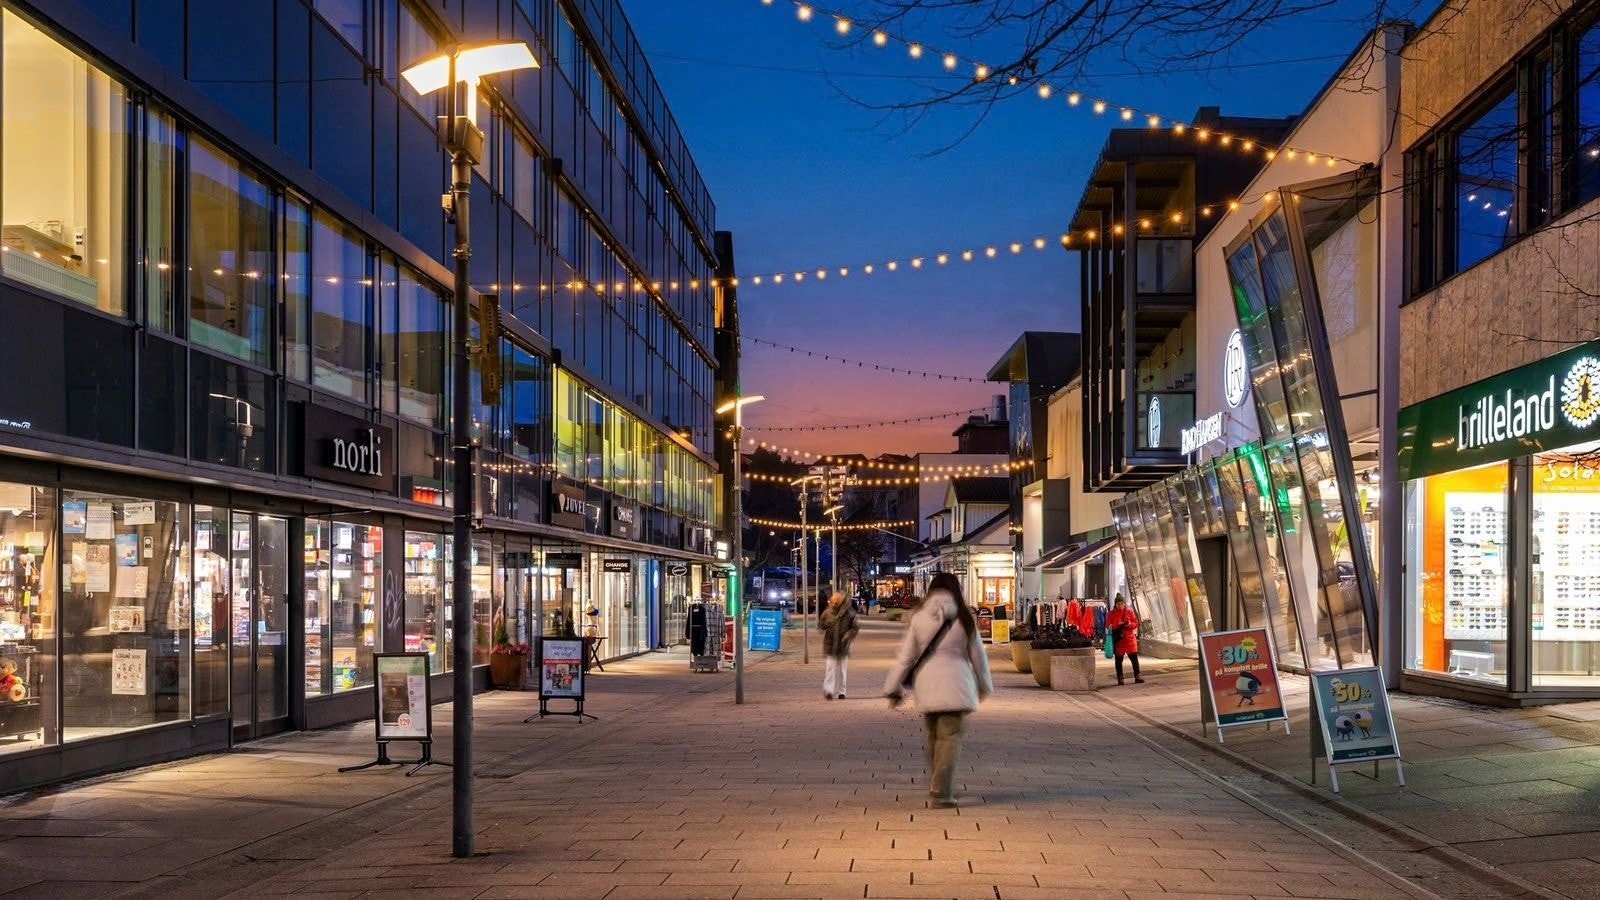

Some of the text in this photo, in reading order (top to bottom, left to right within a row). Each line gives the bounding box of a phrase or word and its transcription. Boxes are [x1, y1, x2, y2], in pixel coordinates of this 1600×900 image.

[1458, 374, 1555, 449] brilleland
[333, 428, 383, 477] norli
[565, 497, 586, 515] JUVEL
[1224, 664, 1251, 673] komplett
[1251, 663, 1268, 671] brille
[399, 718, 411, 726] 129
